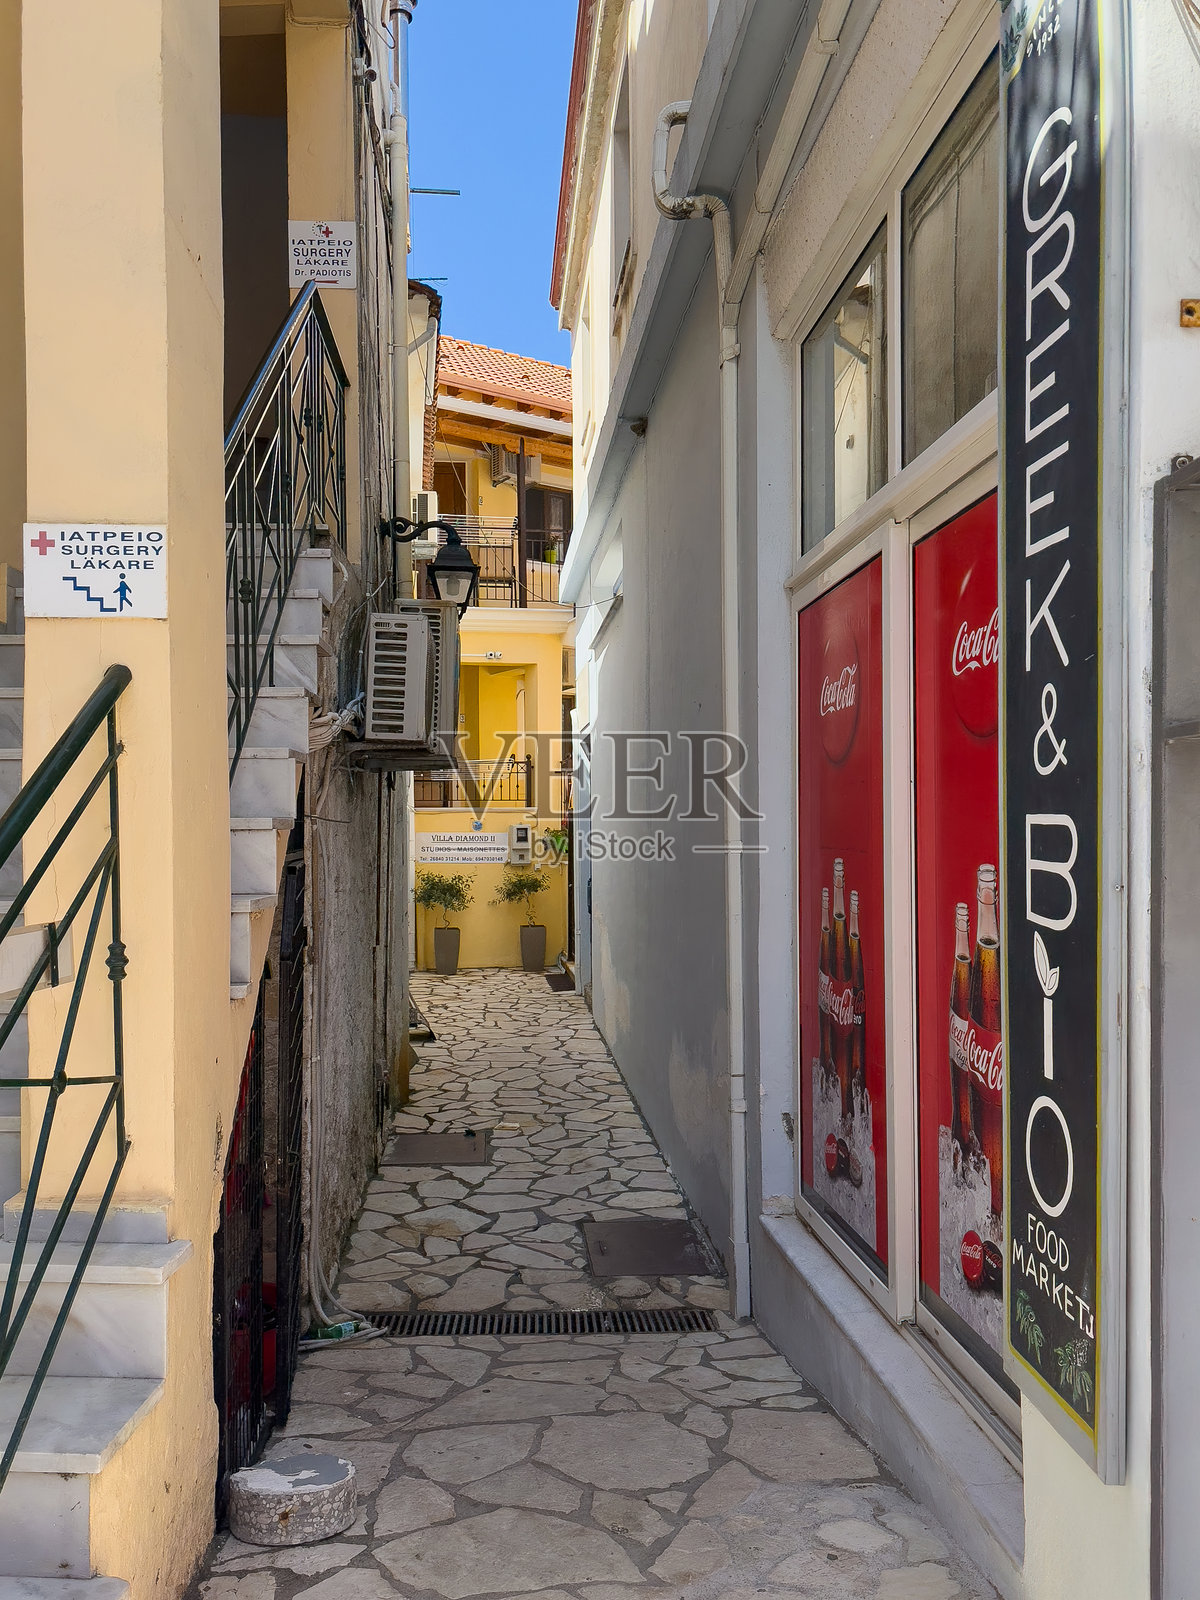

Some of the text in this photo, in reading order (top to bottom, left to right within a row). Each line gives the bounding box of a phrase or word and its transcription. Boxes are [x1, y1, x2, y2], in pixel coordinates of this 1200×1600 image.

[293, 247, 351, 257] SURGERY
[297, 257, 348, 266] LÄKARE
[310, 269, 351, 277] PADIOTIS
[61, 545, 163, 556] SURGERY
[70, 557, 155, 570] LÄKARE
[952, 606, 1000, 676] Coca-Co
[1021, 106, 1079, 1218] GREEK & BIO
[820, 663, 858, 717] Coca-Cola
[967, 1028, 1003, 1092] Coca-Co
[1027, 1212, 1070, 1272] FOOD
